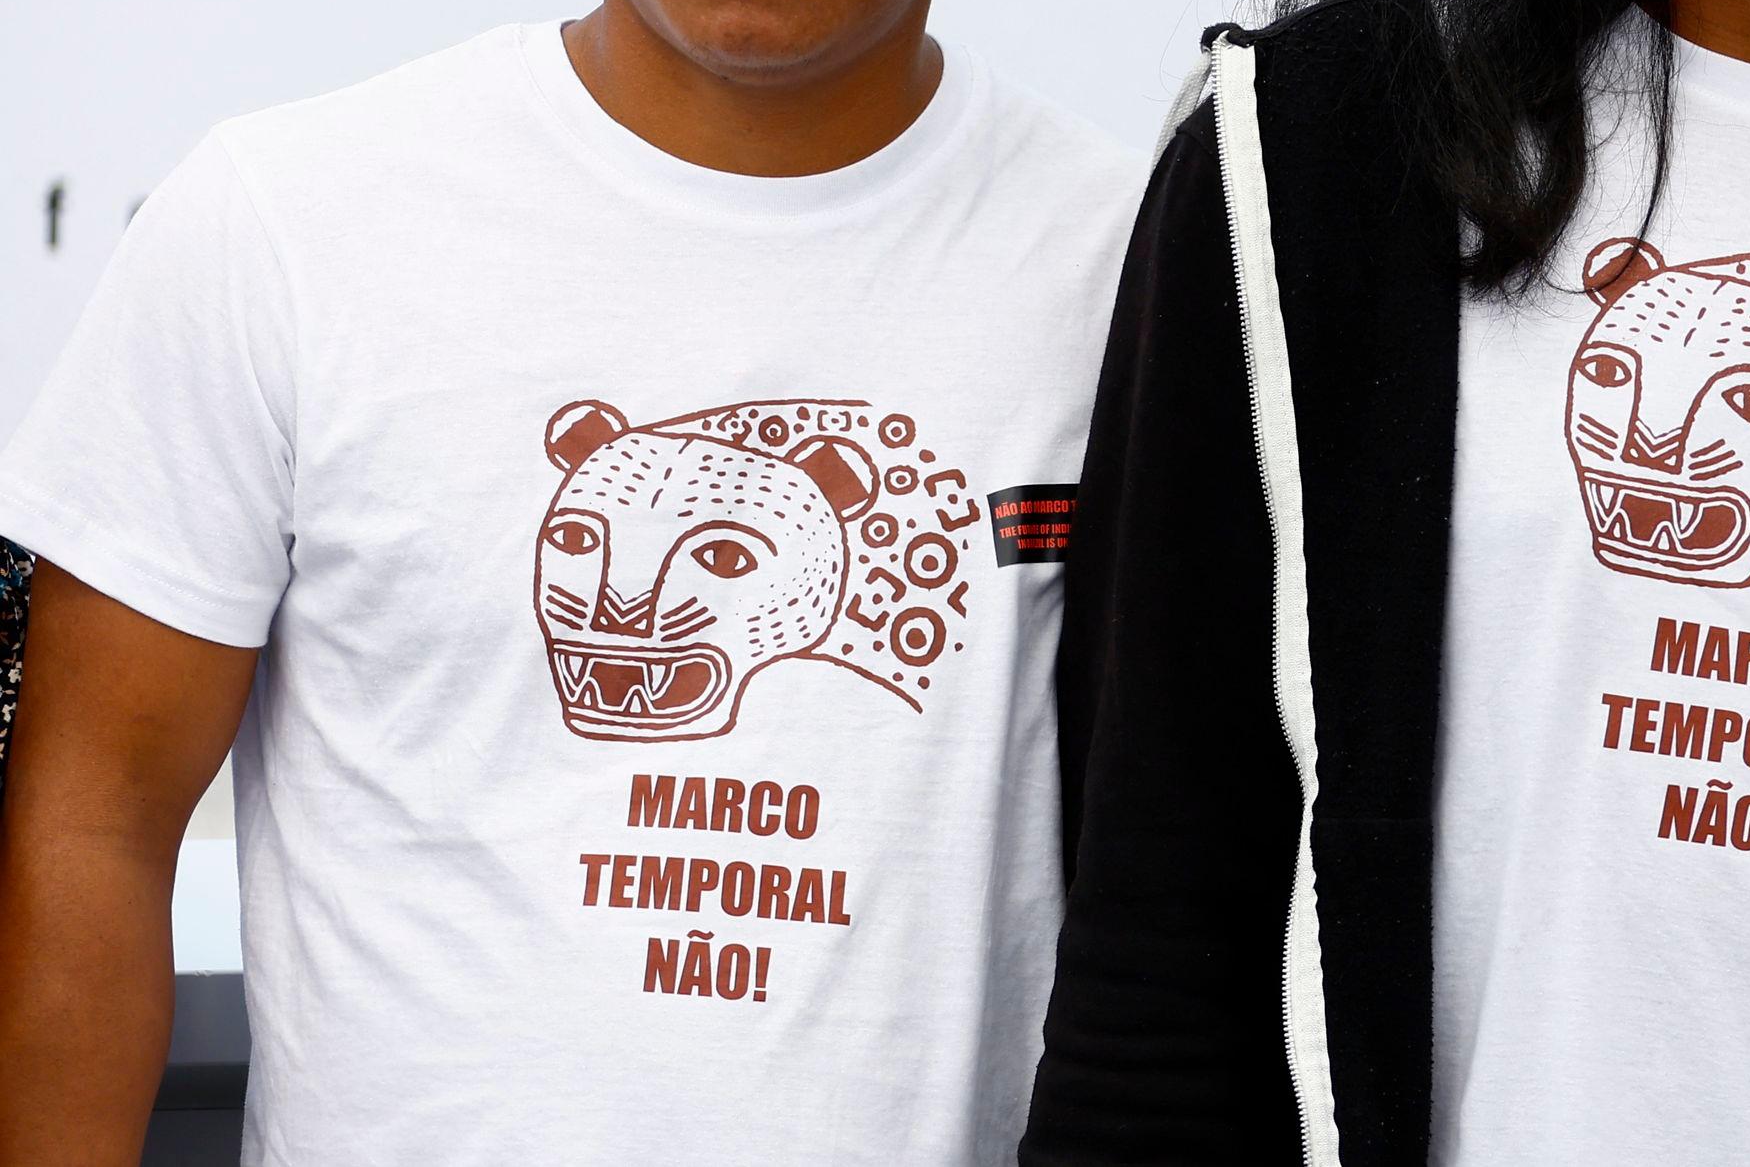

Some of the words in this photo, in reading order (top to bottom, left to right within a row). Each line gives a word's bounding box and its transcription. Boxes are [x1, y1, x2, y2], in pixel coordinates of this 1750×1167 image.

[995, 502, 1018, 519] NÃO
[1020, 500, 1033, 514] AO
[1033, 499, 1069, 514] MARCO
[999, 525, 1017, 539] THE
[1040, 523, 1050, 535] OF
[1046, 537, 1056, 549] IS
[626, 773, 821, 841] MARCO
[579, 852, 852, 926] TEMPORAL
[642, 928, 772, 1003] NÃO!
